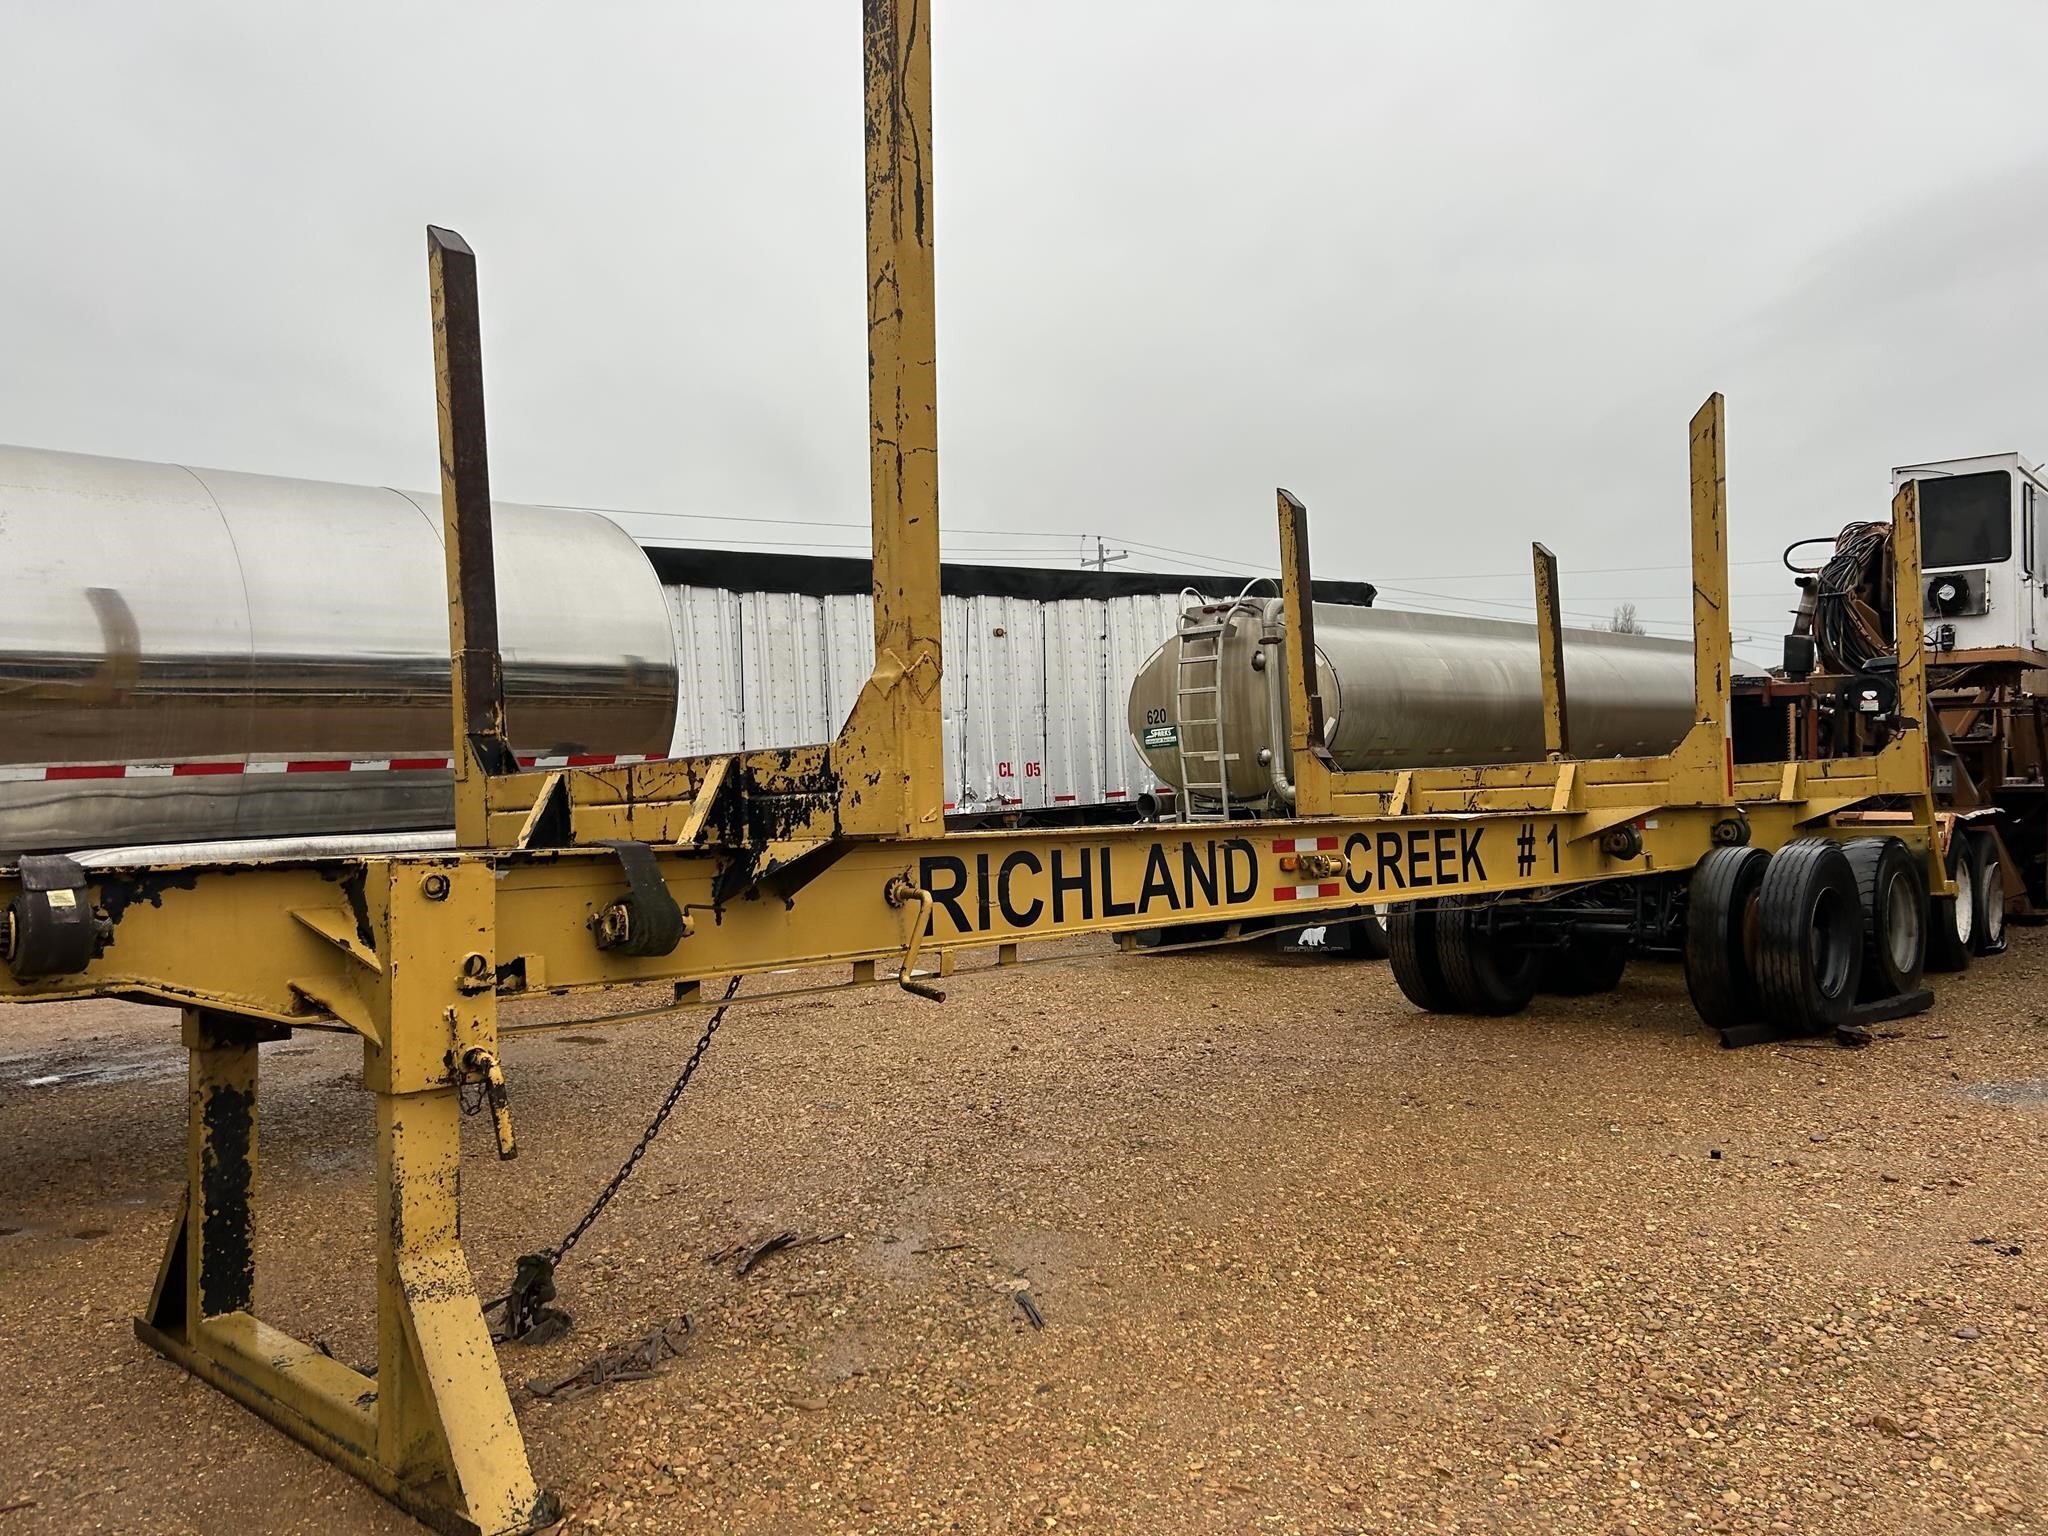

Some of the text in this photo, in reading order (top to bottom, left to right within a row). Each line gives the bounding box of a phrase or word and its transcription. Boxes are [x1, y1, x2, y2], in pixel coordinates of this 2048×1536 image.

[1146, 708, 1167, 725] 620
[998, 762, 1041, 778] CL 05
[919, 839, 1259, 937] RICHLAND
[1344, 827, 1488, 893] CREEK
